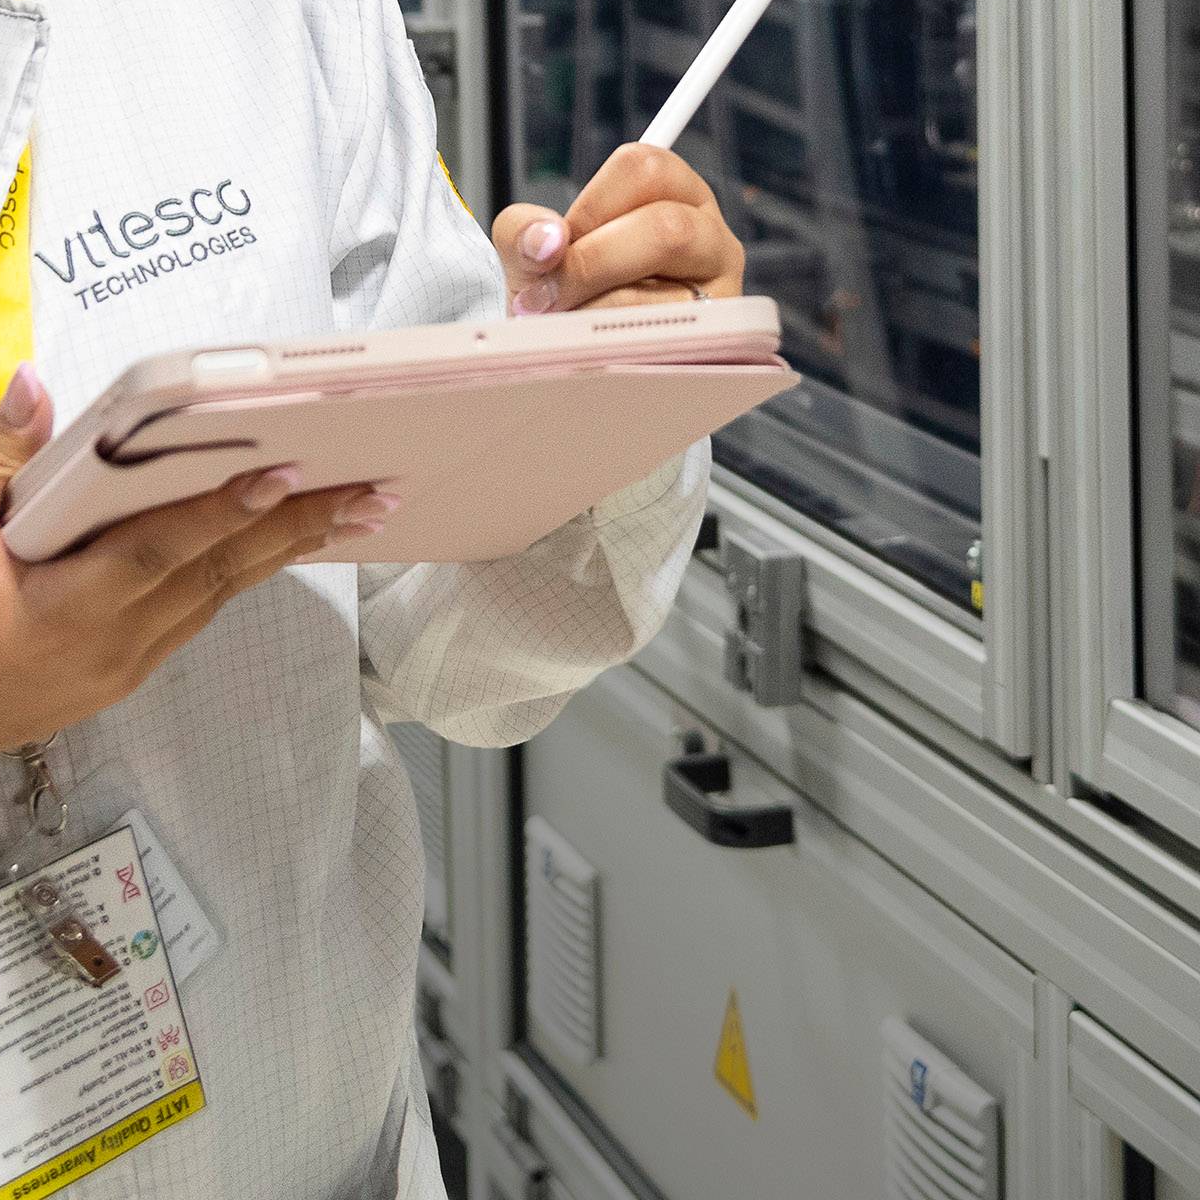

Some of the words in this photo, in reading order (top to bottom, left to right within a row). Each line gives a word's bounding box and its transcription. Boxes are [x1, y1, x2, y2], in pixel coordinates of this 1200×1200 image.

[35, 179, 251, 283] vitesco
[74, 226, 258, 310] TECHNOLOGIES
[100, 1116, 151, 1150] Quality
[156, 1094, 189, 1124] IATF
[13, 1146, 96, 1200] Awareness
